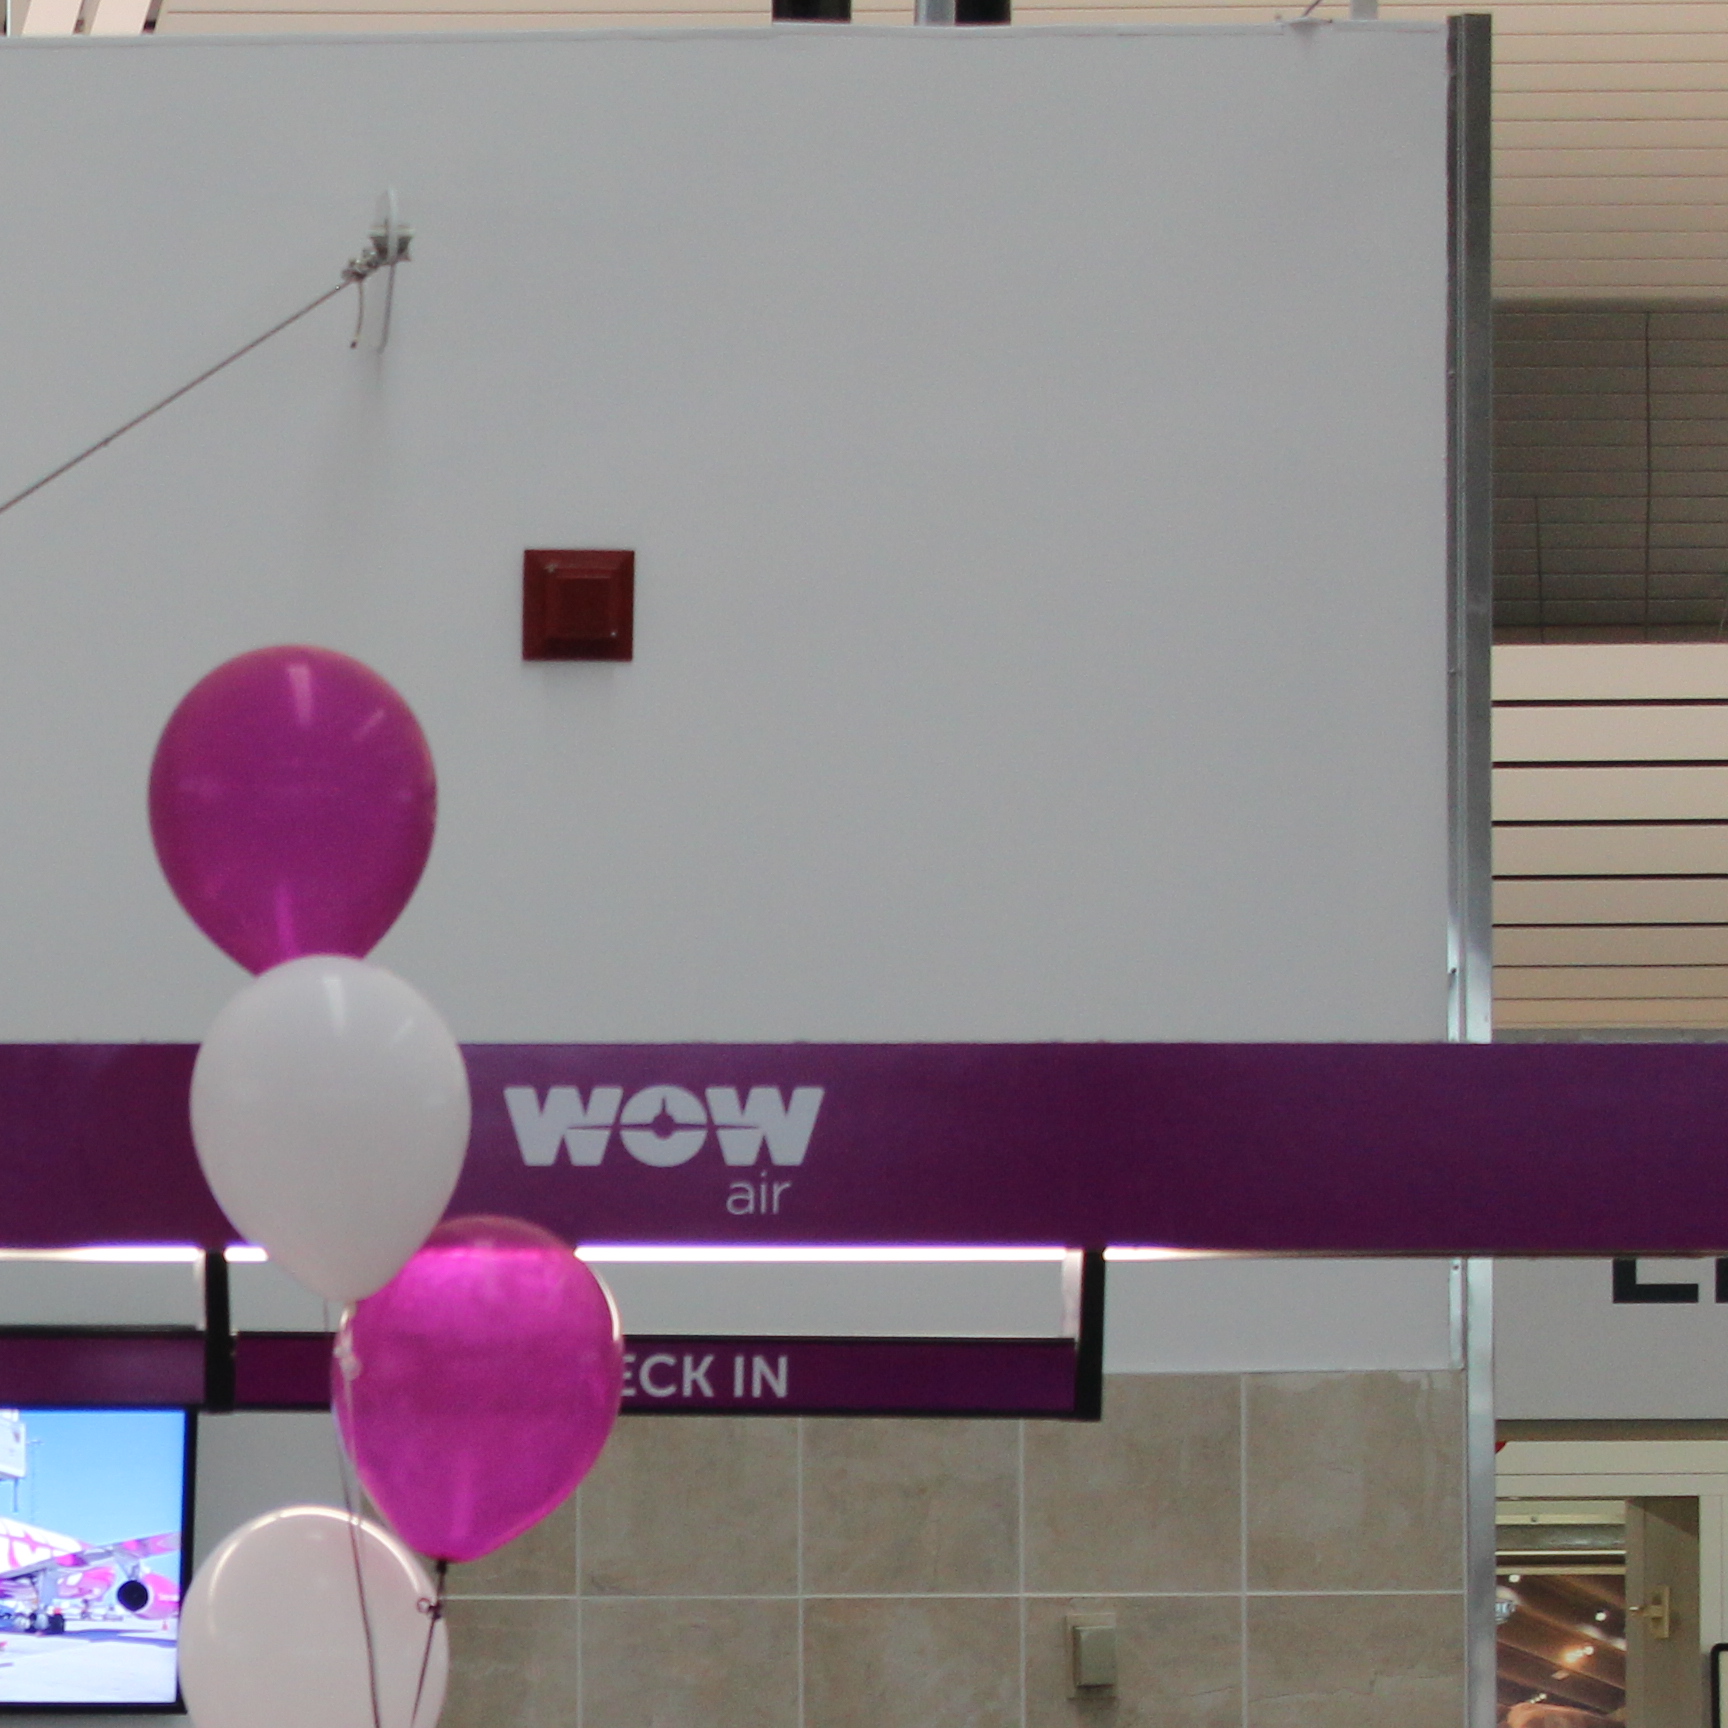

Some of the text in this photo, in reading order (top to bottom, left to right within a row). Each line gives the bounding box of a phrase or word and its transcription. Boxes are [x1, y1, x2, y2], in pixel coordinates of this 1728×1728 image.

[503, 1084, 825, 1167] WOW
[725, 1169, 792, 1215] air
[622, 1353, 788, 1399] ECK IN
